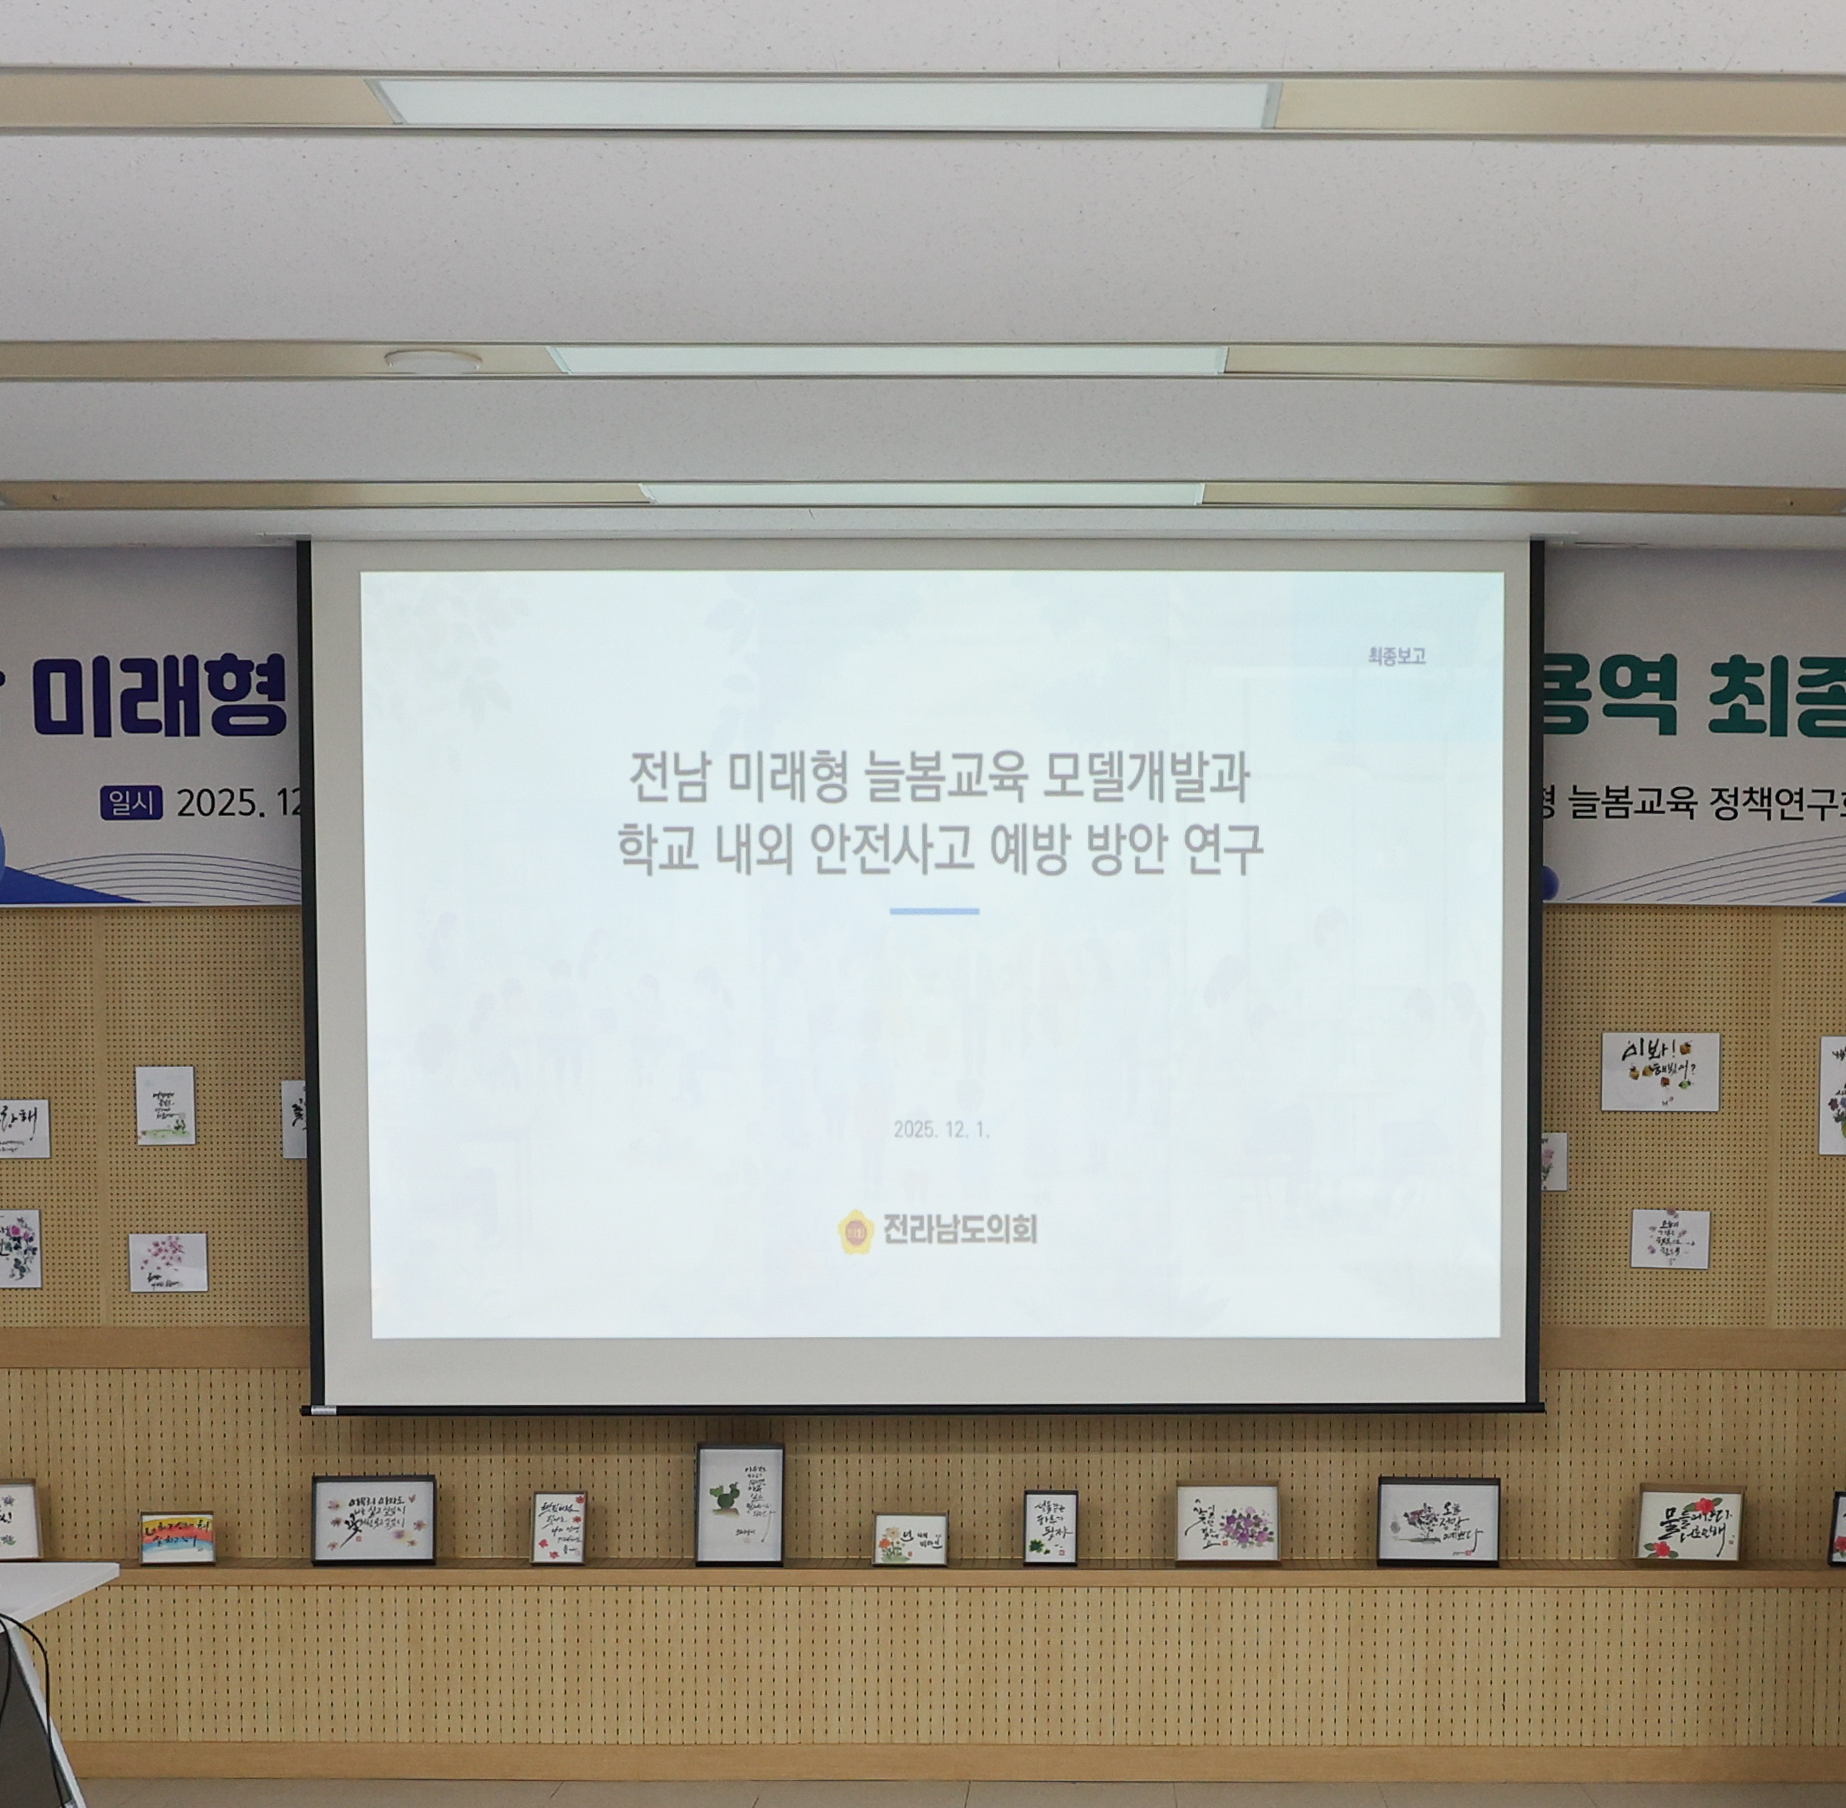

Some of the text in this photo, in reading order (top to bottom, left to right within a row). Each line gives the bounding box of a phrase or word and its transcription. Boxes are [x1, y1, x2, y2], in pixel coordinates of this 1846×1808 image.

[1368, 646, 1427, 666] 최종보고
[33, 652, 287, 738] 미래형
[629, 750, 1251, 804] 전남 미래형 늘봄교육 모델개발과
[108, 790, 156, 816] 일시
[177, 787, 266, 818] 2025.
[1568, 785, 1698, 821] 늘봄교육
[617, 822, 1265, 876] 학교 내외 안전사고 예방 방안 연구
[894, 1120, 990, 1139] 2025. 12. 1.
[884, 1214, 1038, 1244] 전라남도의회
